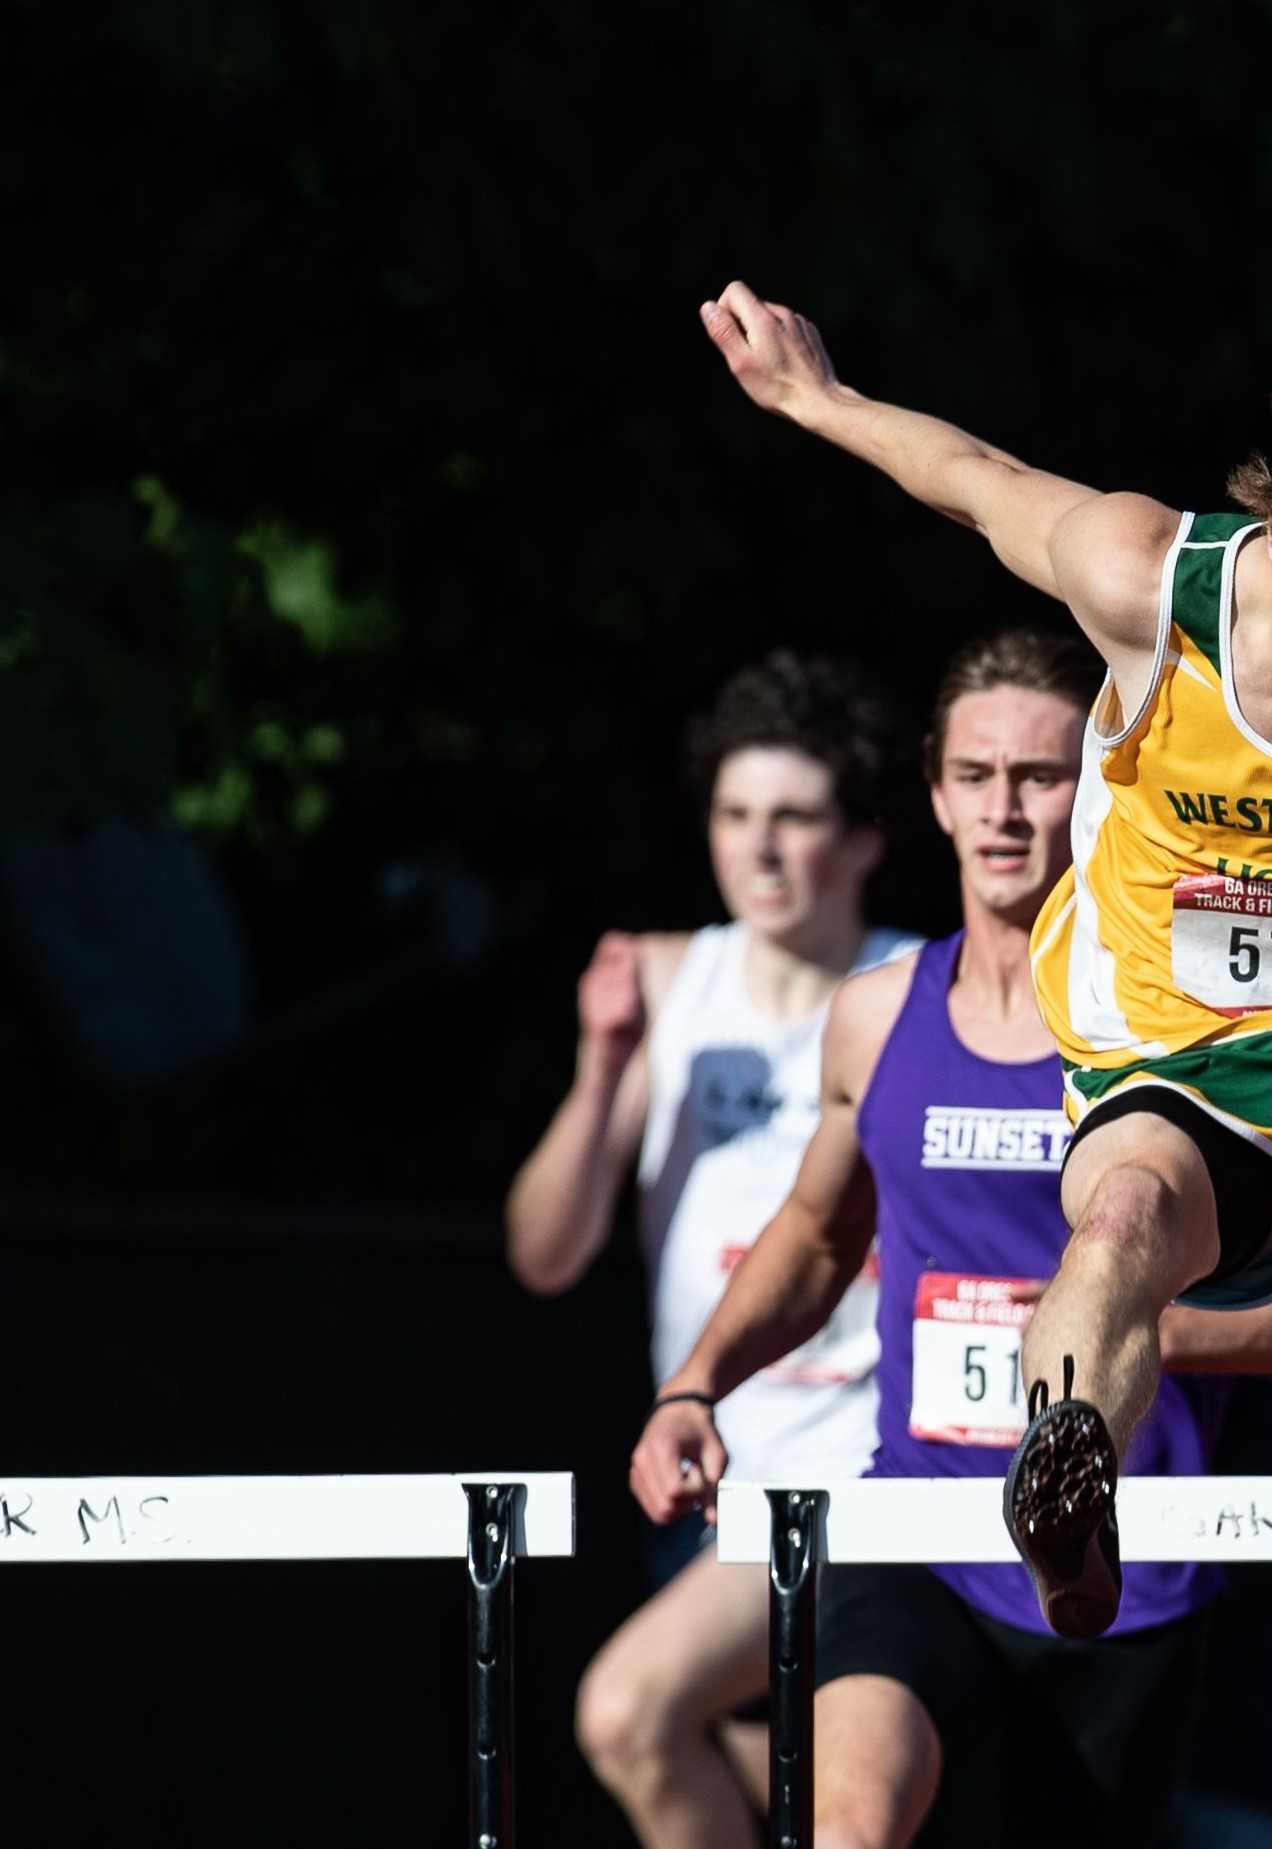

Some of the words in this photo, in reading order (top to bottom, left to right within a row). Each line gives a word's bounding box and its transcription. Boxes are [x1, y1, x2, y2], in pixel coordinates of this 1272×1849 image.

[1224, 877, 1244, 895] 6A
[1194, 893, 1241, 911] TRACK
[1245, 898, 1256, 912] &
[922, 1116, 1073, 1162] SUNSET
[963, 1344, 1022, 1406] 51
